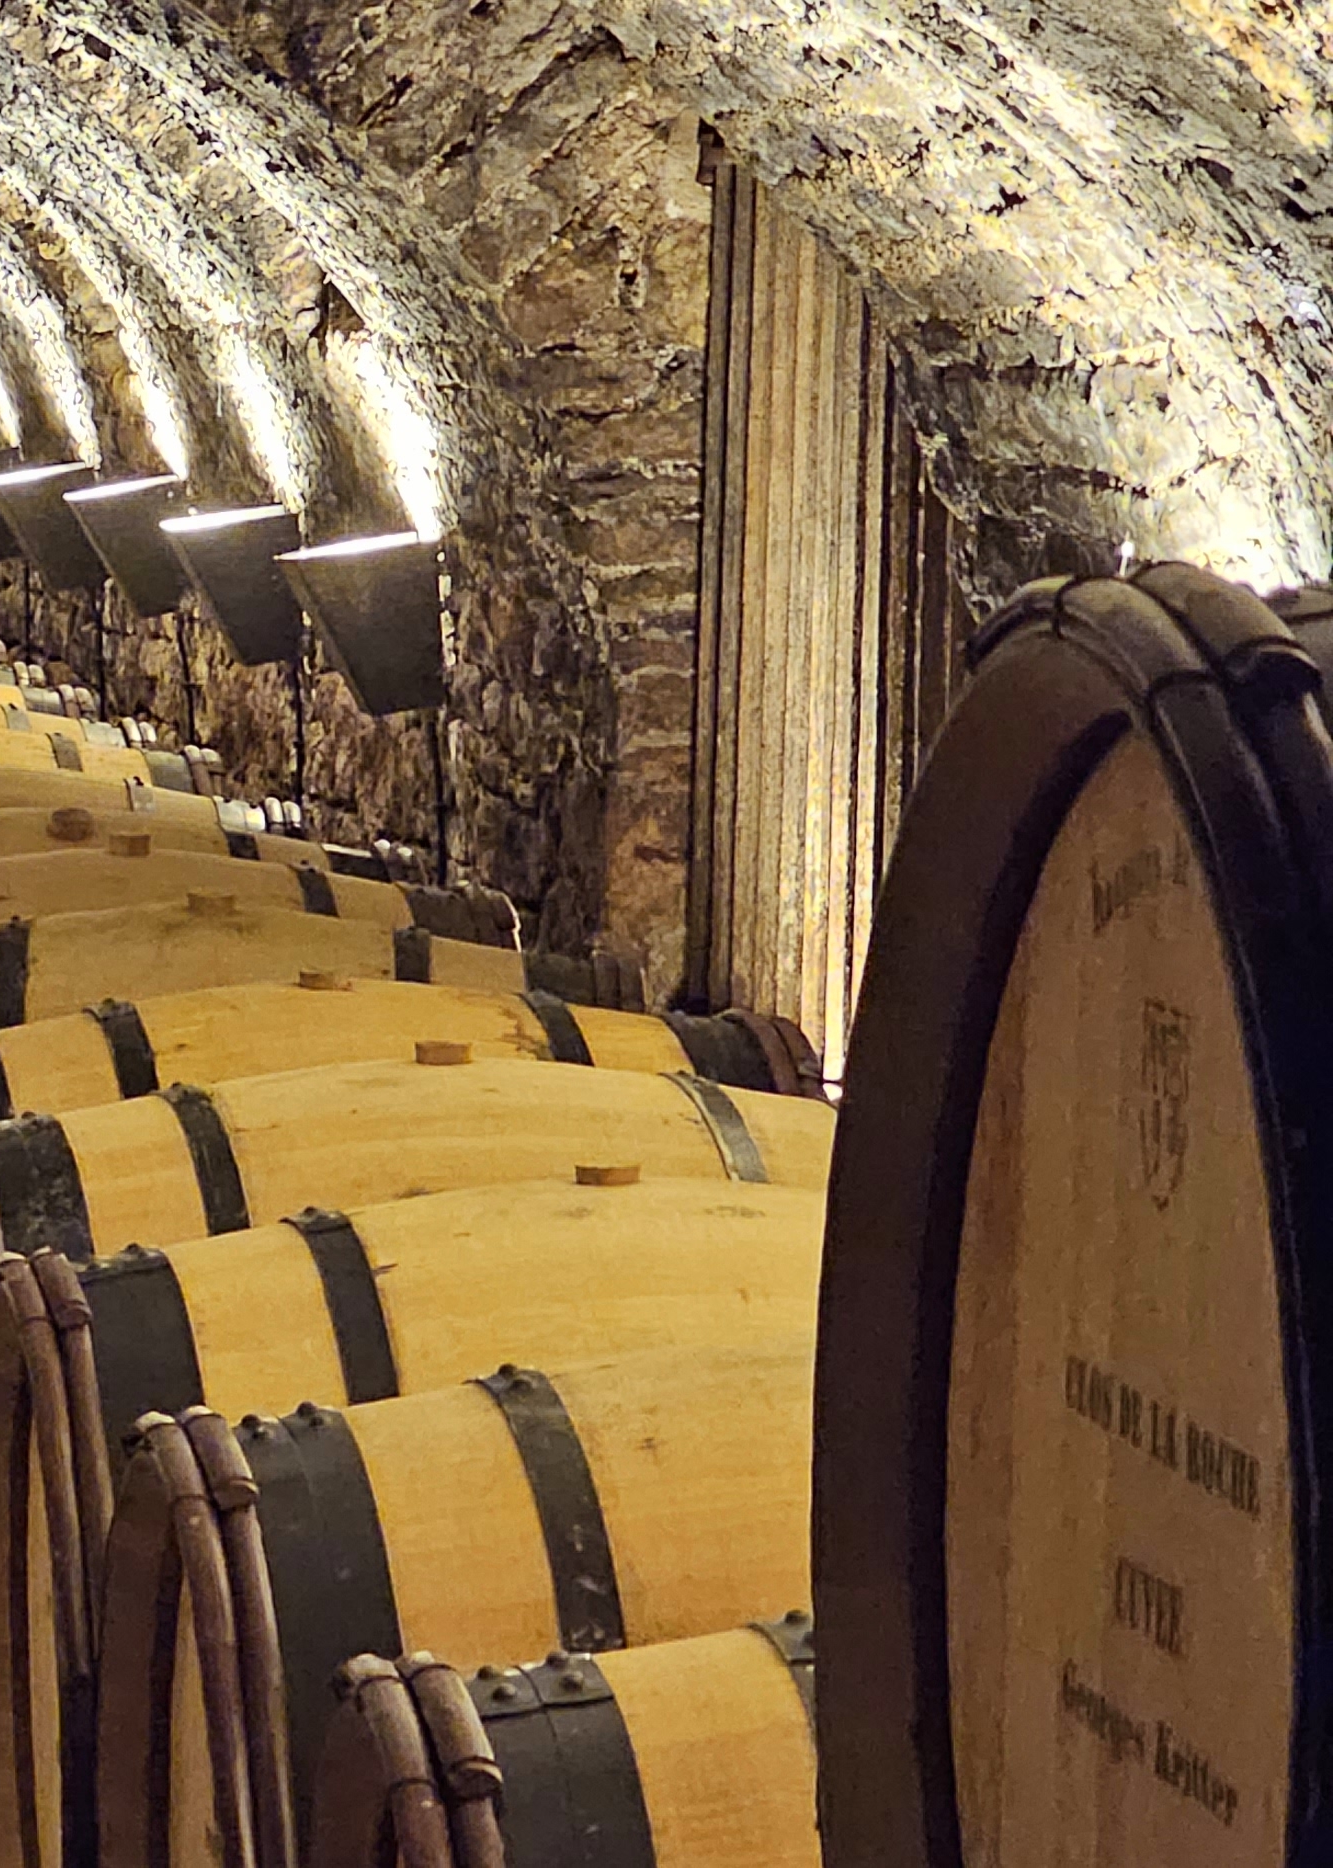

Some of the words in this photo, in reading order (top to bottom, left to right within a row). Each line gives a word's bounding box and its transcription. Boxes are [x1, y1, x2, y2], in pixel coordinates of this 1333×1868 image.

[1119, 1381, 1143, 1448] DE
[1150, 1399, 1179, 1472] LA
[1186, 1416, 1261, 1523] ROCHE
